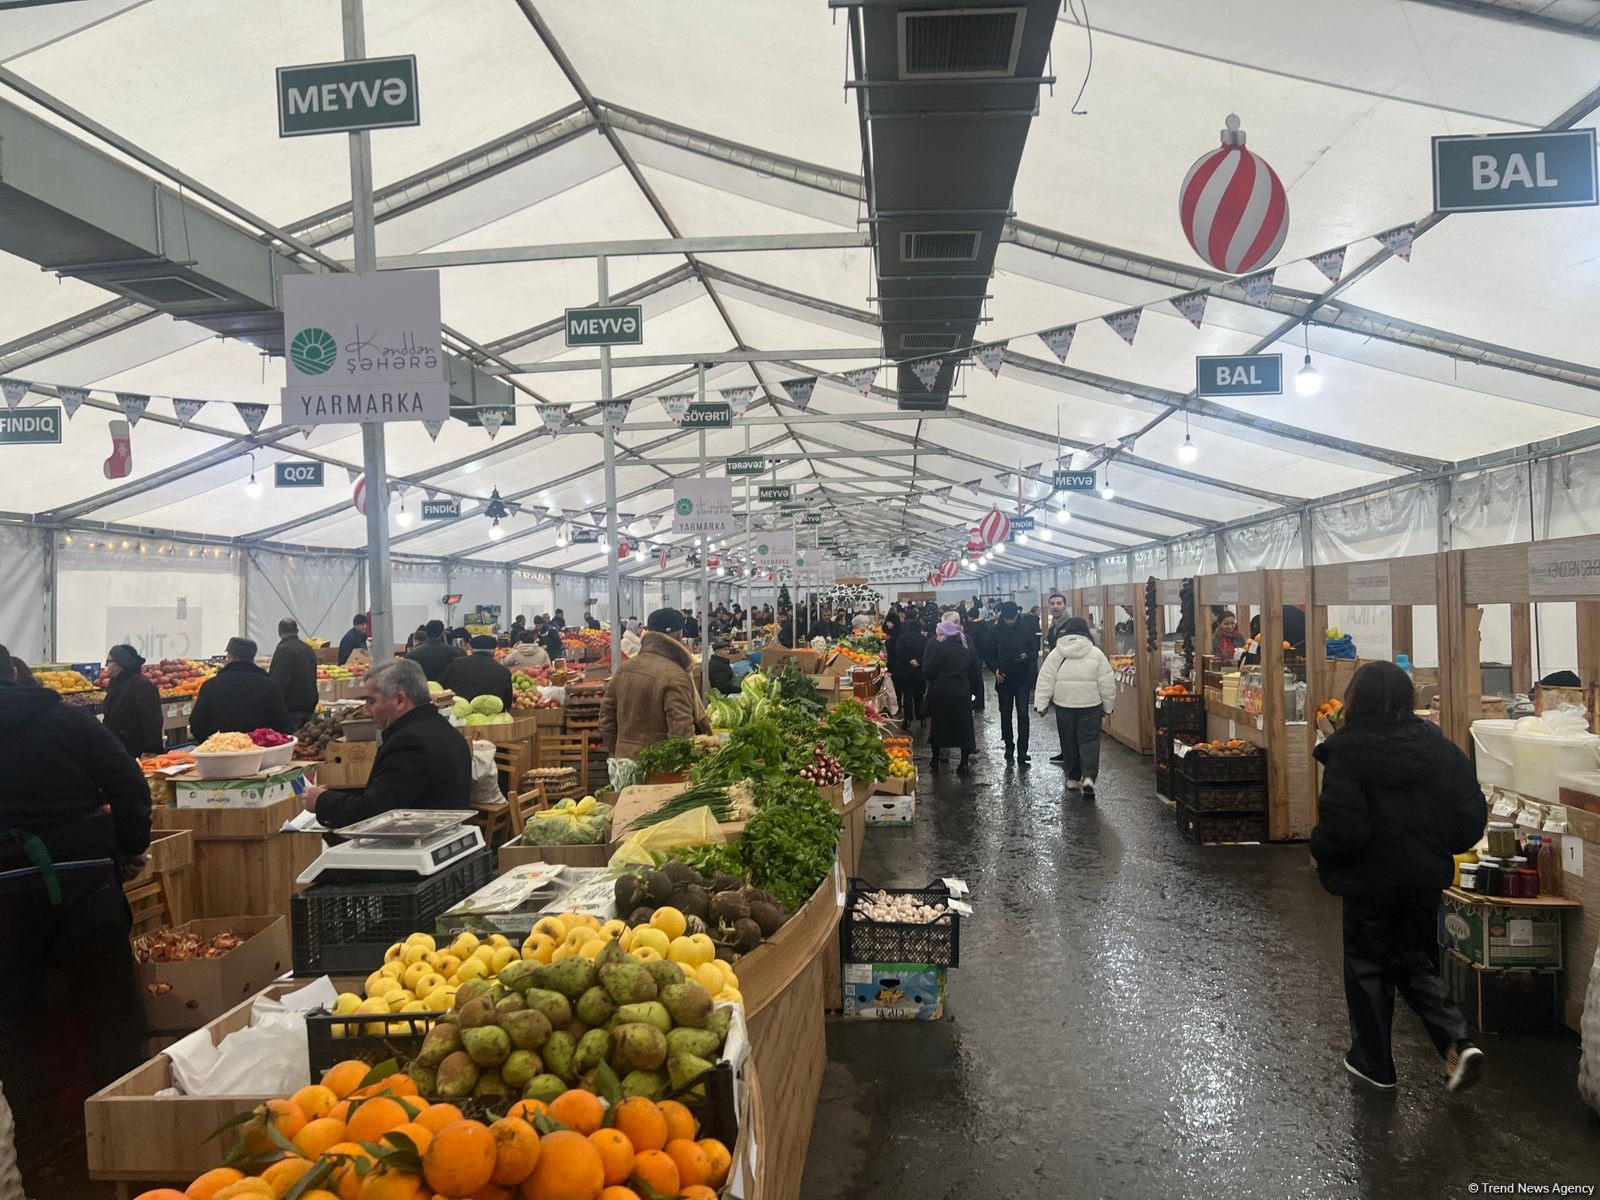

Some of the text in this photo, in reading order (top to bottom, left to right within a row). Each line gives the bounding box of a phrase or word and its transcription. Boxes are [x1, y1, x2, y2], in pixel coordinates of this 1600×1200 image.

[288, 77, 408, 115] MEYVƏ
[1471, 152, 1558, 190] BAL
[570, 317, 636, 335] MEYVƏ
[347, 355, 437, 375] ŞƏHƏRƏ
[1216, 365, 1262, 386] BAL
[301, 392, 424, 416] YARMARKA
[0, 416, 55, 433] FINDIQ
[728, 462, 763, 470] TƏRƏVƏZ
[284, 467, 315, 481] QOZ
[1055, 476, 1093, 486] MEYVƏ
[760, 490, 789, 498] MEYVƏ
[424, 504, 458, 514] FINDIQ
[680, 522, 726, 531] YARMARKA
[1011, 519, 1033, 528] ENDİR
[1569, 847, 1575, 860] 1
